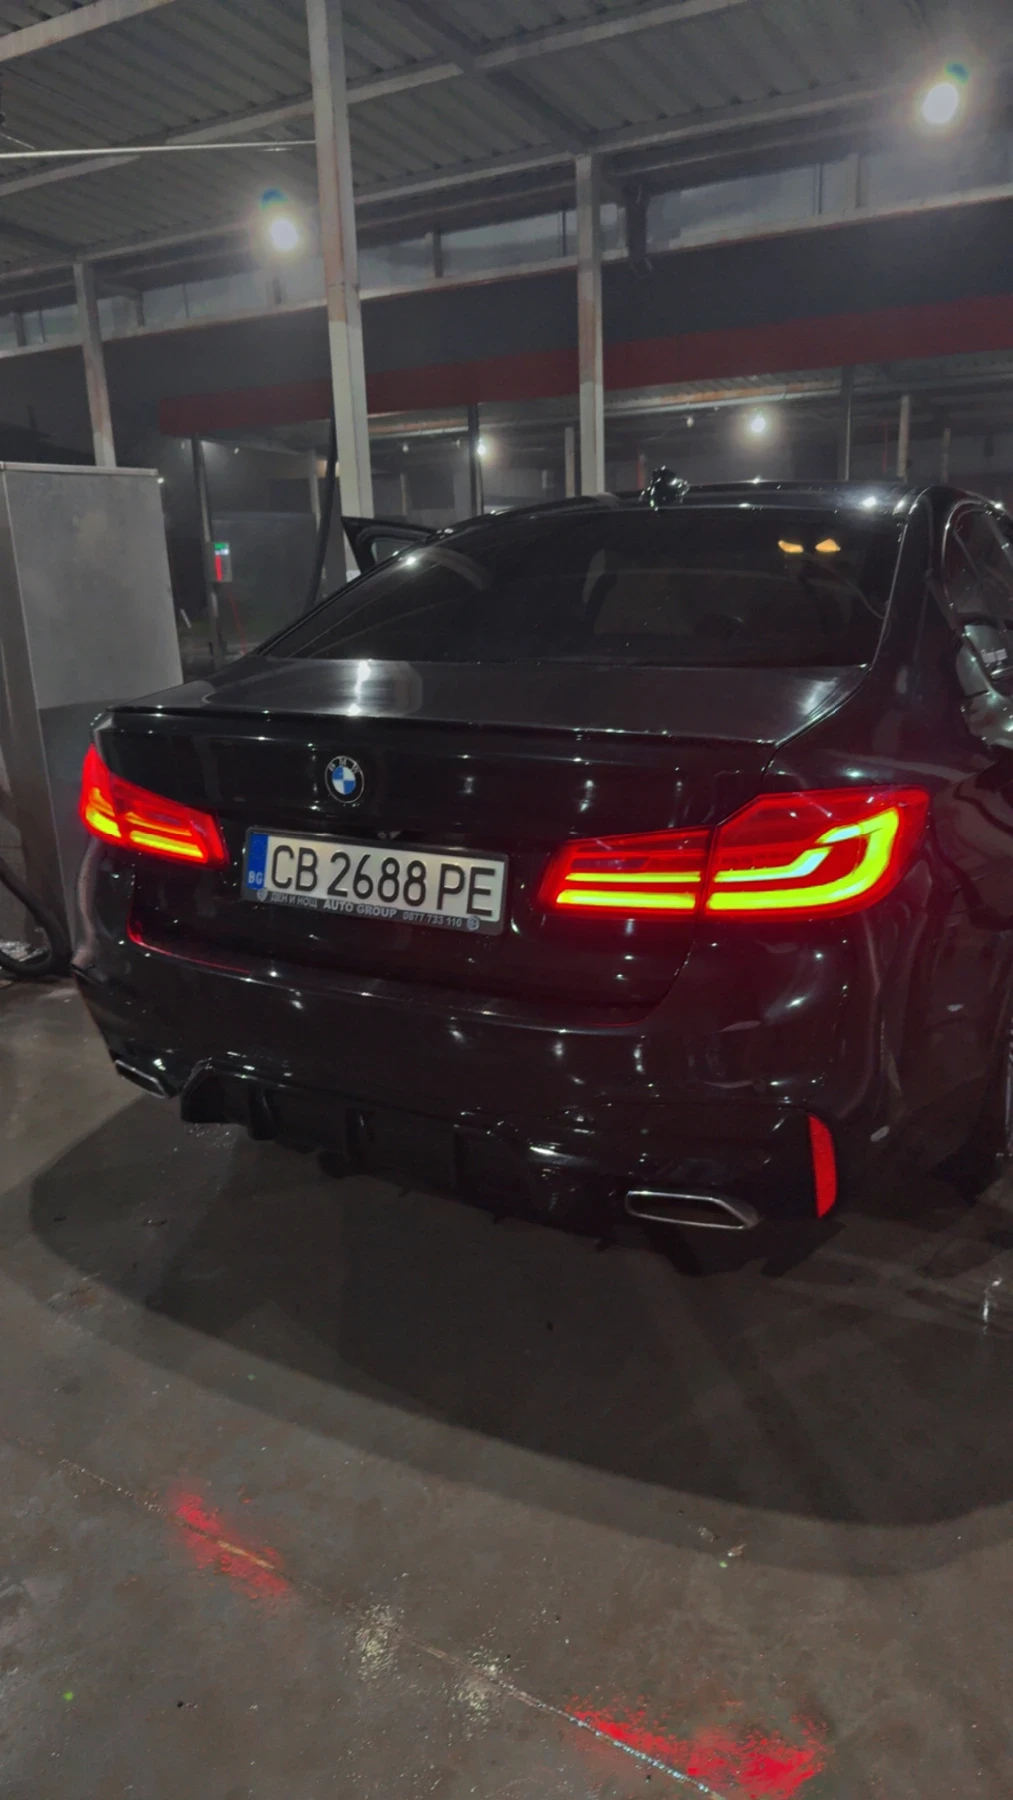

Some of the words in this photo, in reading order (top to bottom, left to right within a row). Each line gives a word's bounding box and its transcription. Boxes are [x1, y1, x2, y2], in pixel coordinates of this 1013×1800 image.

[248, 870, 263, 885] BG
[271, 844, 318, 892] CB
[327, 851, 427, 907] 2688
[436, 862, 496, 917] PE
[323, 899, 354, 912] AUTO
[356, 903, 398, 918] GROUP
[402, 911, 425, 922] 0877
[426, 914, 444, 925] 733
[444, 916, 463, 928] 110
